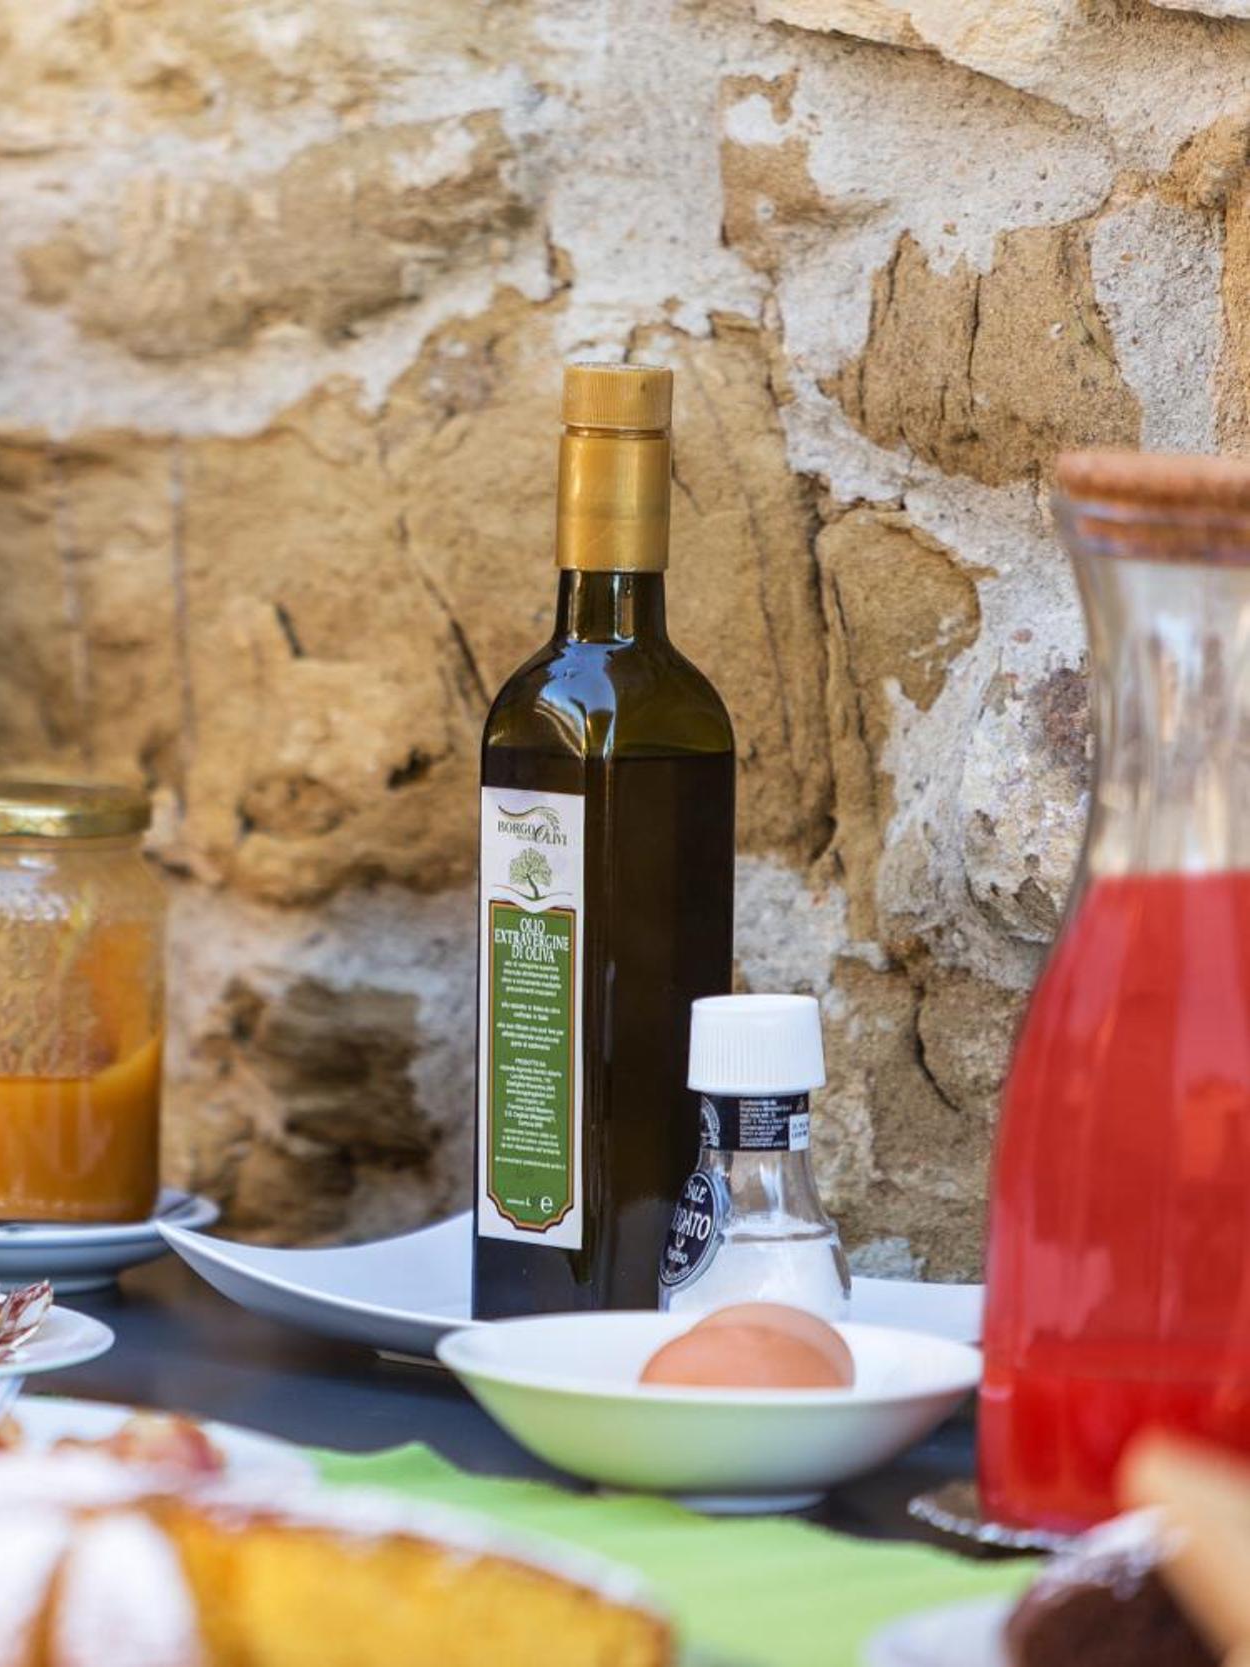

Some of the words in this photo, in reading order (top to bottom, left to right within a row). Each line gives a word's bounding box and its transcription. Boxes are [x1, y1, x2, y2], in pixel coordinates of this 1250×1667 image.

[498, 820, 536, 837] BORGO
[520, 918, 546, 935] OLIO
[494, 928, 570, 952] EXTRAVERGINE
[511, 944, 524, 960] DI
[525, 946, 556, 964] OLIVA
